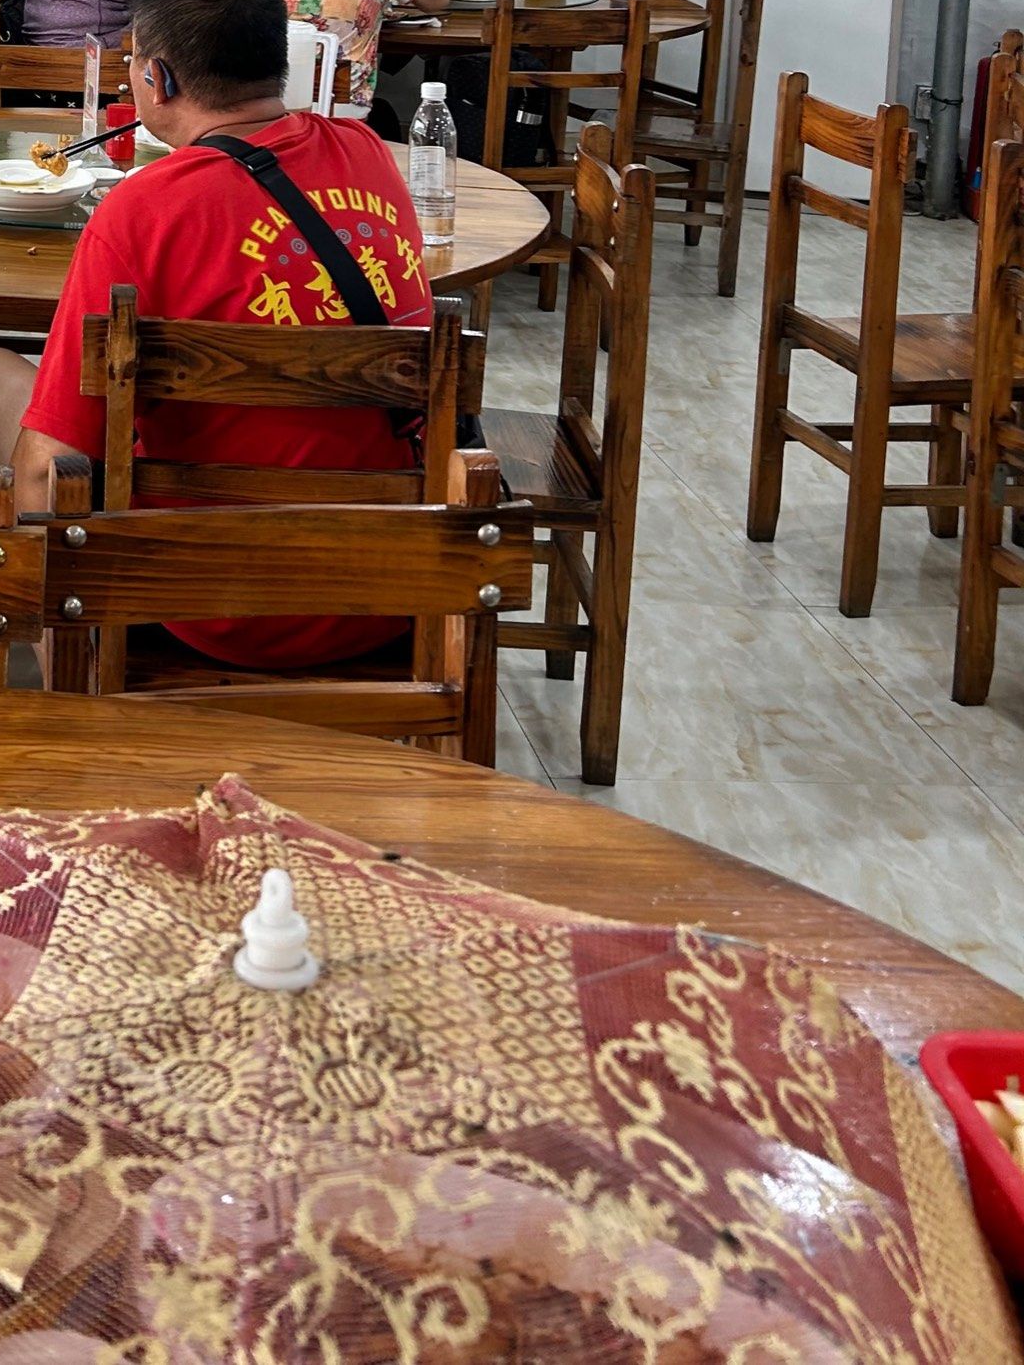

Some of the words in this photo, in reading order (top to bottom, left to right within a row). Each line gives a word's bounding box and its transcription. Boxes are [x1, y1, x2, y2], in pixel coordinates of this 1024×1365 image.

[305, 187, 399, 227] YOUNG
[247, 233, 426, 326] 有志青年
